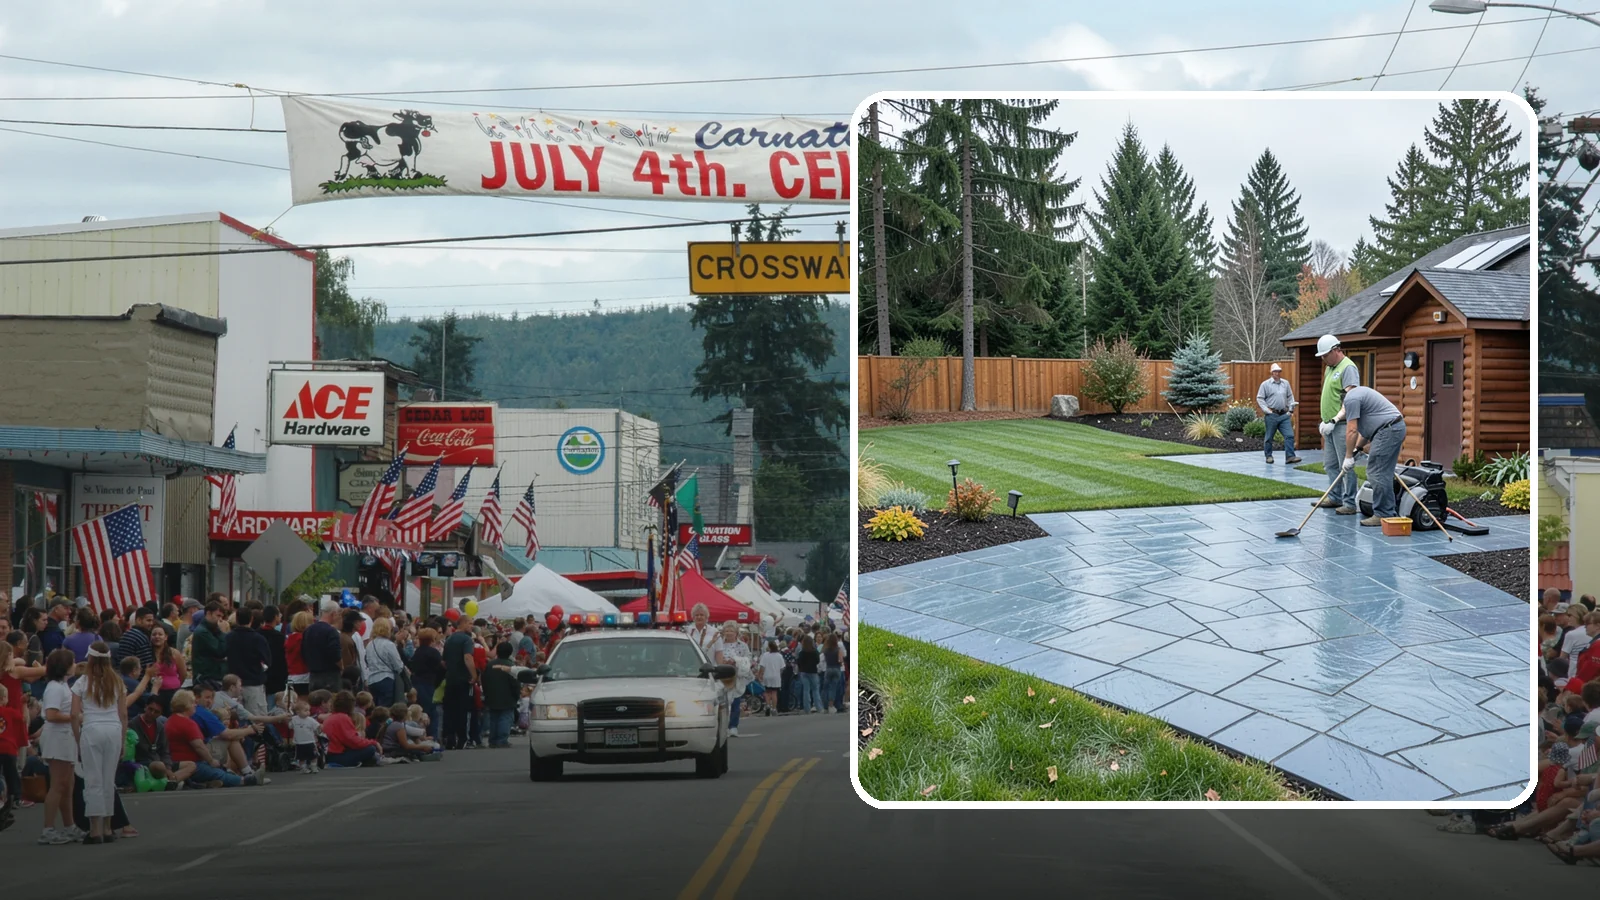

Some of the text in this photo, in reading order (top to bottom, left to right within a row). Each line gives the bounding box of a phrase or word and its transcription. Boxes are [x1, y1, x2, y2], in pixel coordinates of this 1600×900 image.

[695, 121, 850, 149] Carnat
[481, 141, 604, 193] JULY
[632, 150, 746, 197] 4th.
[697, 254, 850, 280] CROSSWA
[282, 380, 373, 420] ACE
[406, 409, 485, 422] CEDAR LOG
[284, 421, 370, 436] Hardware
[416, 428, 476, 447] Coca-Cola
[83, 485, 155, 495] St. Vincent de Paul
[688, 526, 741, 535] CRNATION
[700, 535, 730, 543] GLASS
